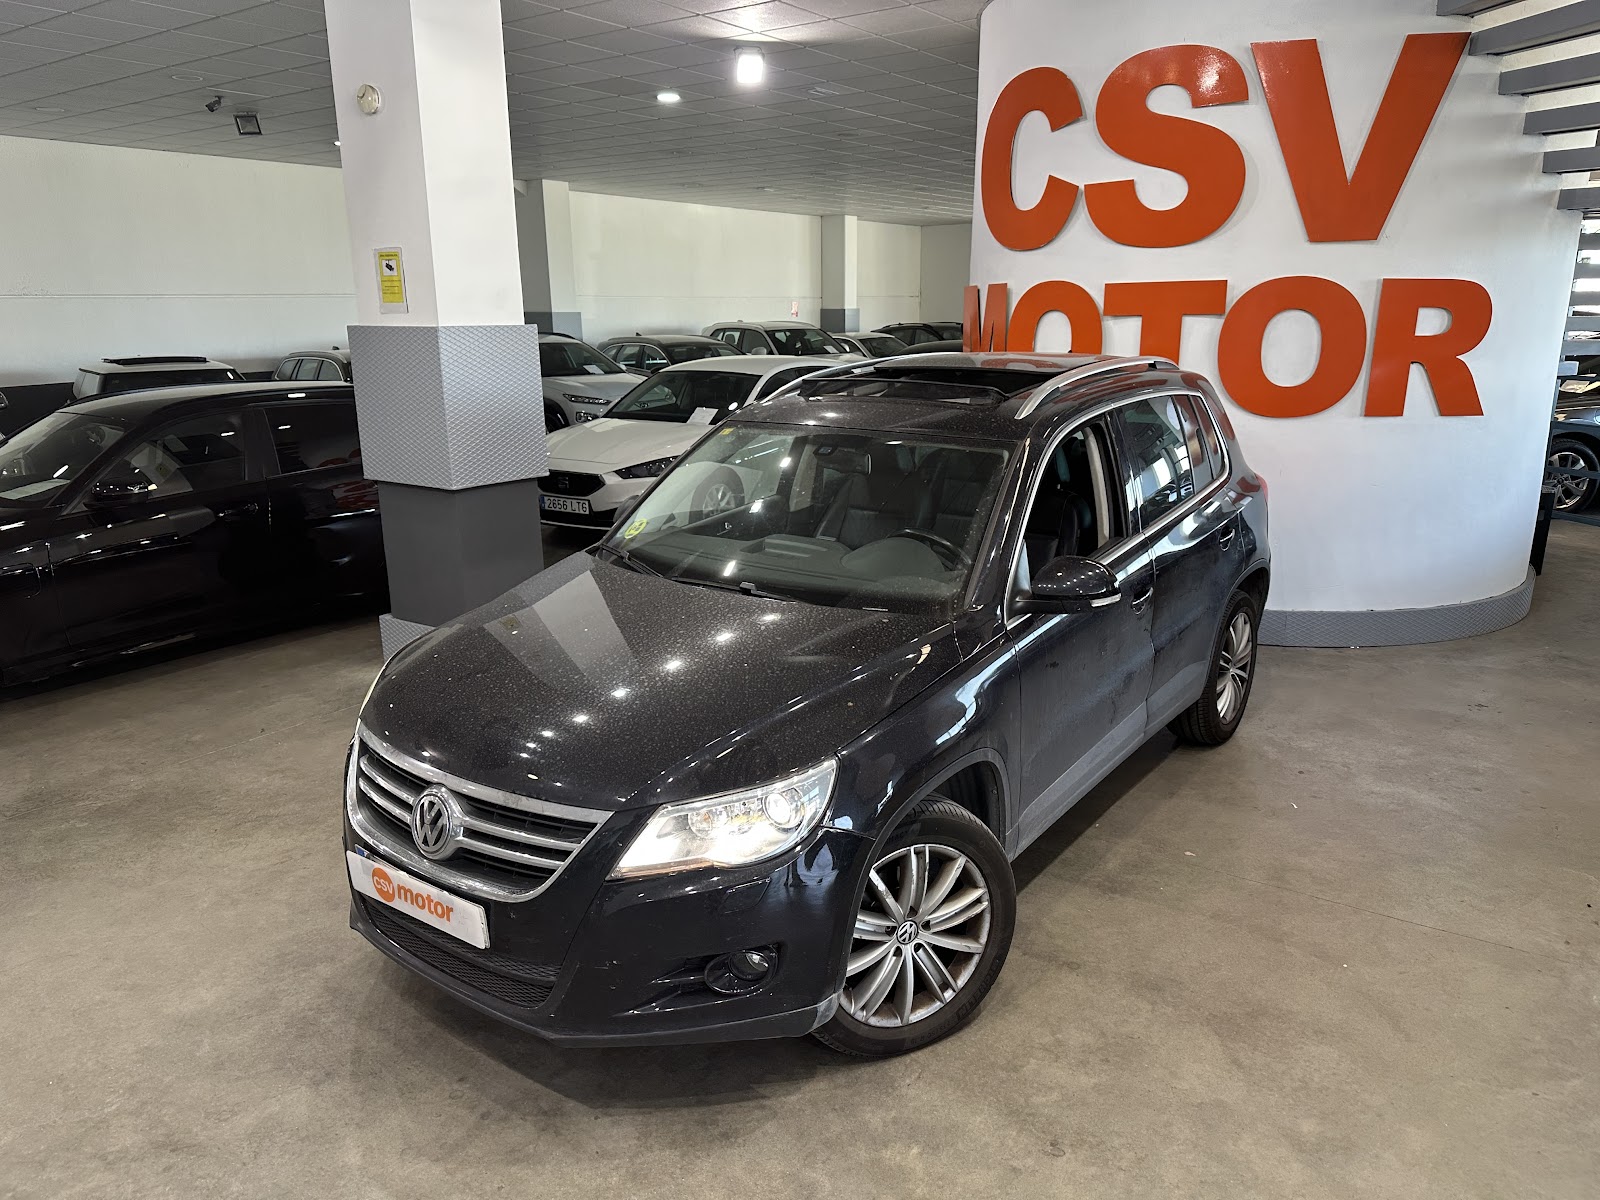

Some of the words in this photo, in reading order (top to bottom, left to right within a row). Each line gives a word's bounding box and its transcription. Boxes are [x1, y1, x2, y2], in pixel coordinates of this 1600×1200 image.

[981, 32, 1472, 251] CSV
[963, 276, 1493, 418] MOTOR
[546, 498, 568, 511] 2656
[373, 875, 393, 895] CSV
[397, 883, 454, 923] motor
